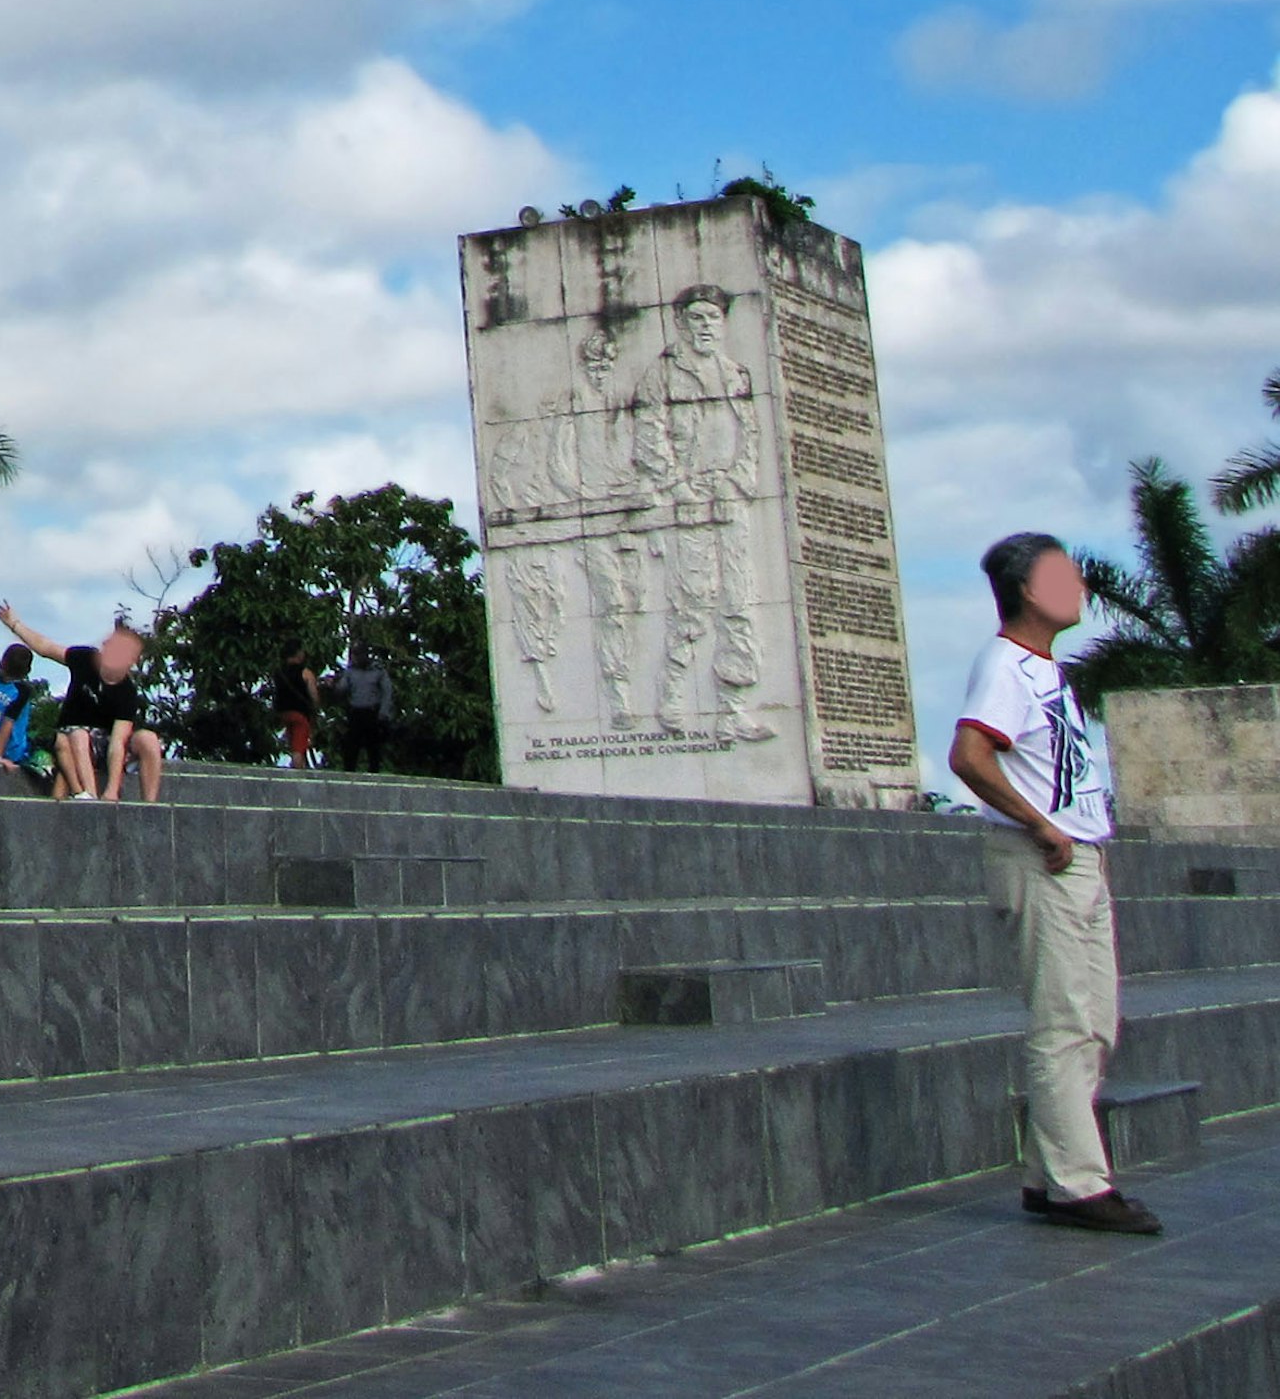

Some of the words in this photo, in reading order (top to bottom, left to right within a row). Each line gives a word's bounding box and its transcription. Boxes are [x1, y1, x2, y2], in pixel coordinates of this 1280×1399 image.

[550, 735, 599, 747] TRABAJO
[602, 732, 669, 744] VOLUNTARIO
[688, 729, 709, 740] UNA
[525, 748, 572, 761] ESCUELA
[576, 746, 636, 758] CREADORA
[639, 745, 654, 755] DE
